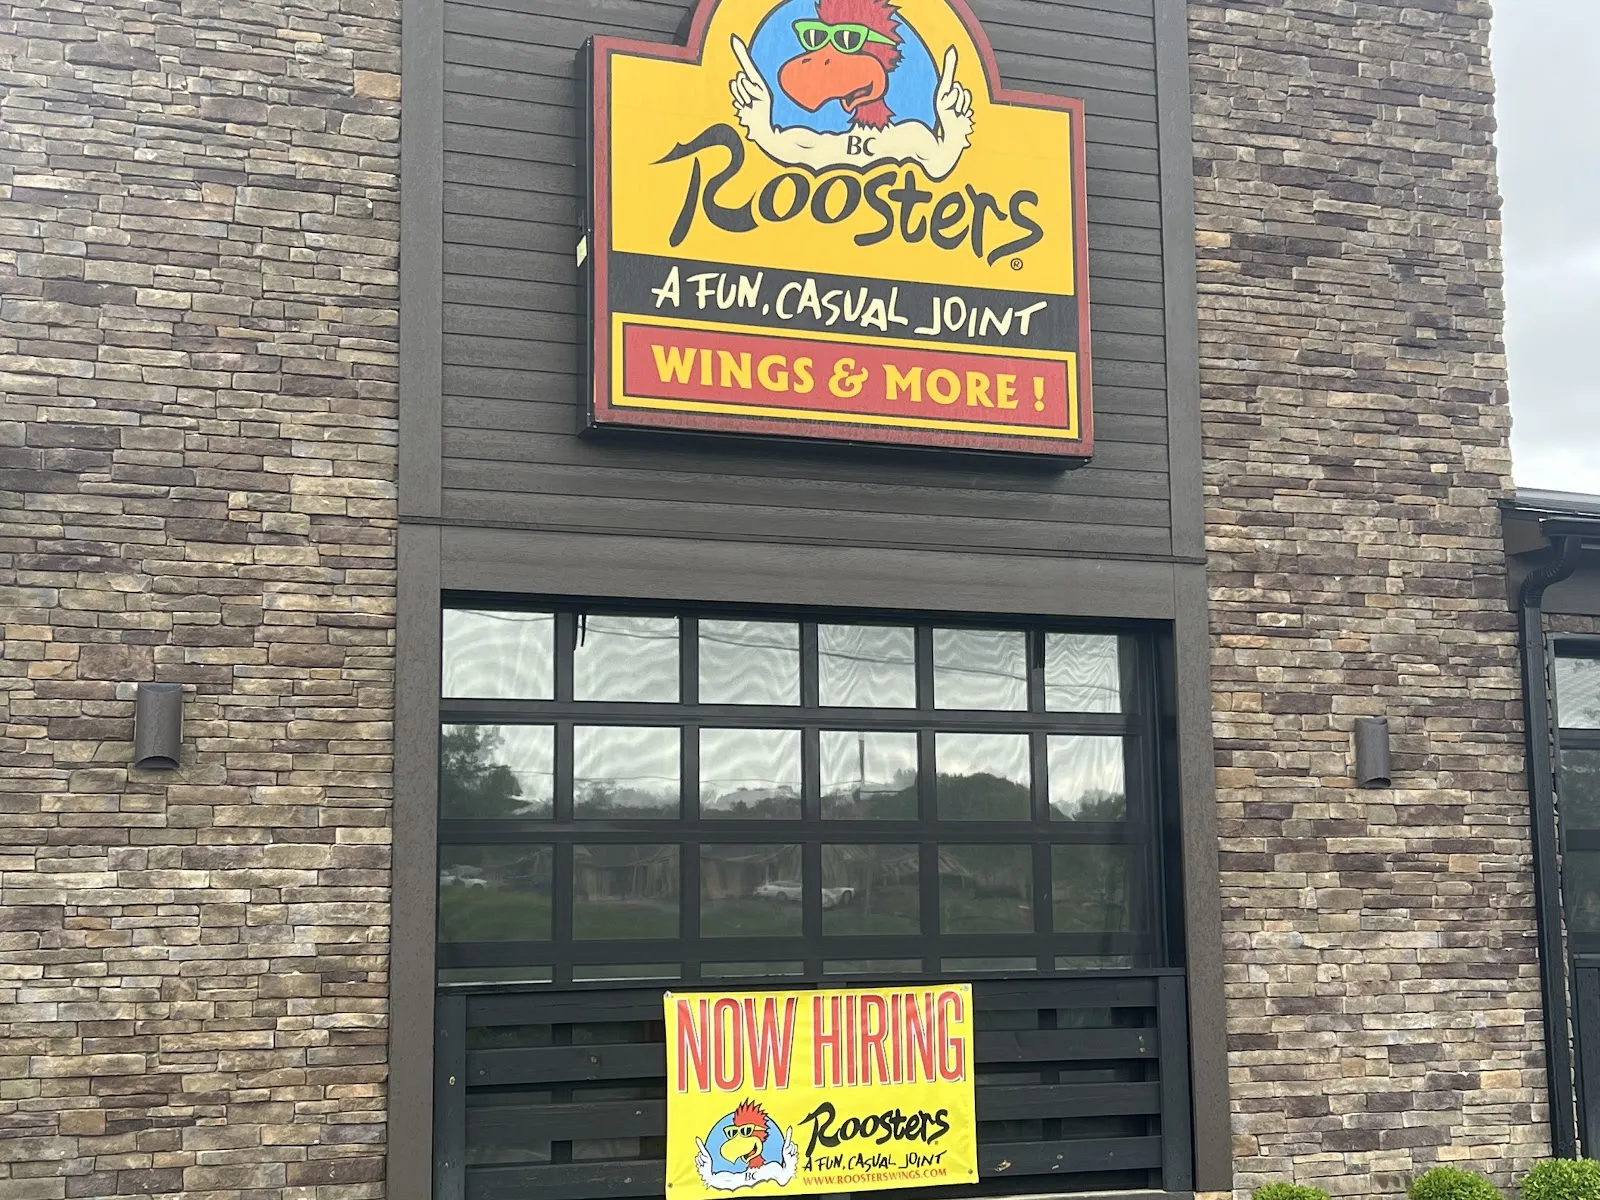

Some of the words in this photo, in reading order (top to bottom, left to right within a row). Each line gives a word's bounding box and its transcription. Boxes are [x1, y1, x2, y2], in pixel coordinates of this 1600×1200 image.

[846, 135, 876, 157] BC
[649, 123, 1044, 268] Roosters
[651, 266, 679, 309] A
[686, 273, 769, 317] FUN,
[776, 277, 909, 332] CASUAL
[914, 297, 1048, 338] JOINT
[650, 345, 815, 394] WINGS
[828, 357, 869, 399] &
[882, 364, 1019, 409] MORE
[676, 996, 798, 1094] NOW
[812, 990, 967, 1089] HIRING
[797, 1101, 950, 1157] Roosters
[744, 1172, 757, 1182] BC
[802, 1156, 813, 1172] A
[848, 1152, 897, 1172] CASUAL
[898, 1150, 948, 1169] JOINT
[802, 1168, 947, 1186] WWW.ROOSTERSWINGS.COM
